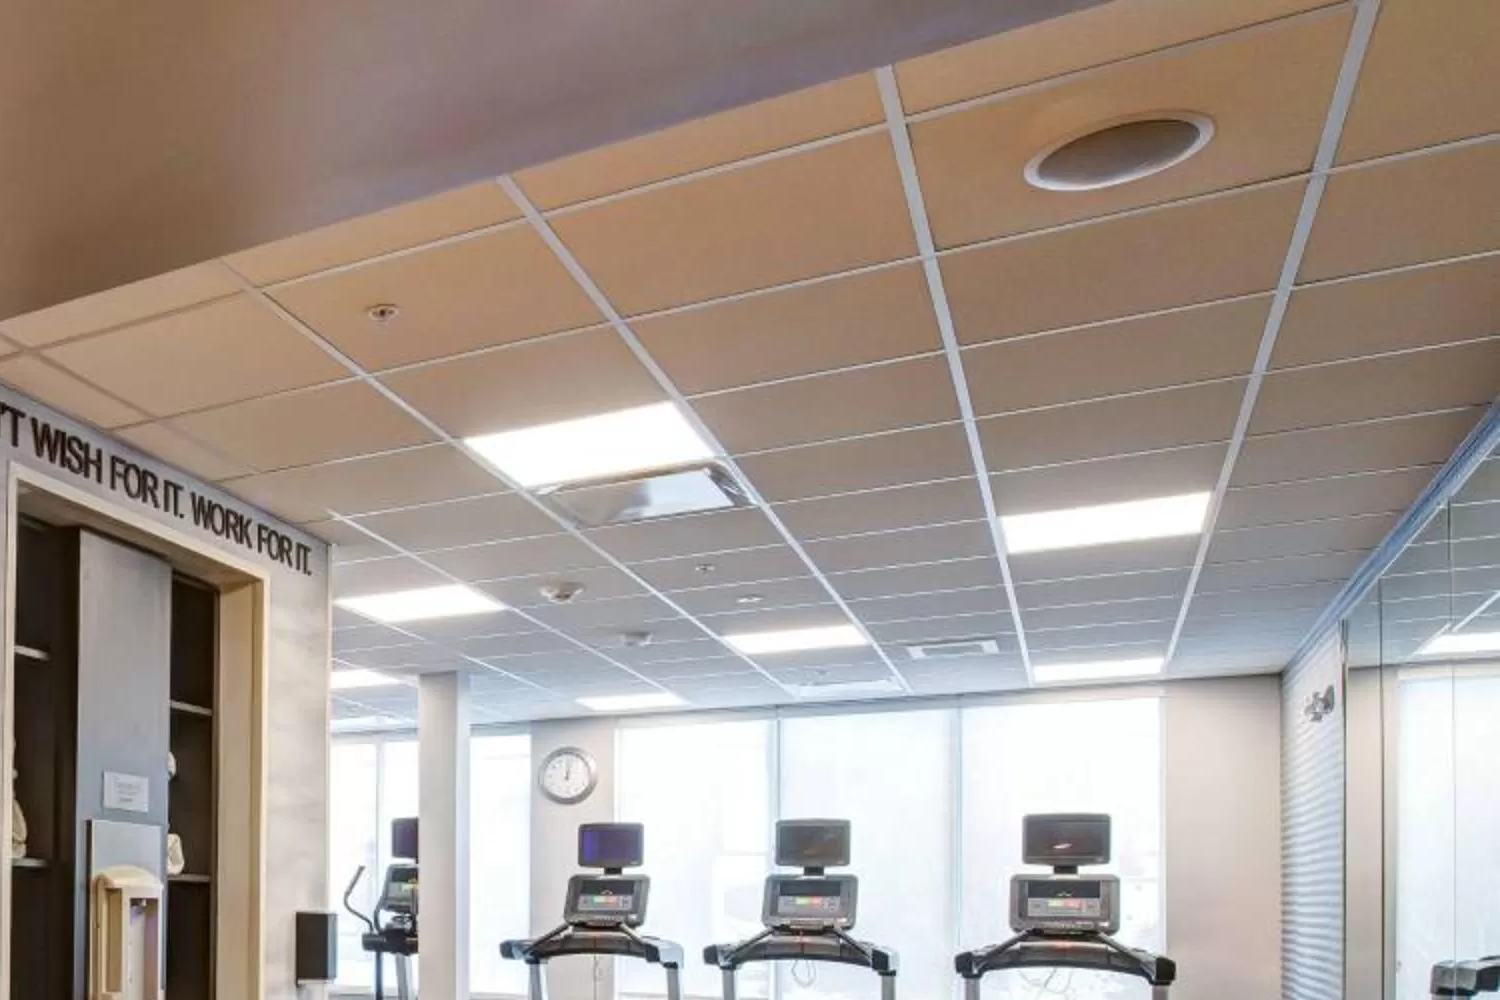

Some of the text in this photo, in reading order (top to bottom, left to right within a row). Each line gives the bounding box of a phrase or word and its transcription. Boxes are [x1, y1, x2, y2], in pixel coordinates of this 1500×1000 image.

[30, 417, 103, 484] WISH
[110, 455, 160, 509] FOR
[163, 480, 185, 519] IT.
[190, 491, 253, 549] WORK
[257, 523, 293, 568] FOR
[295, 542, 313, 576] IT.
